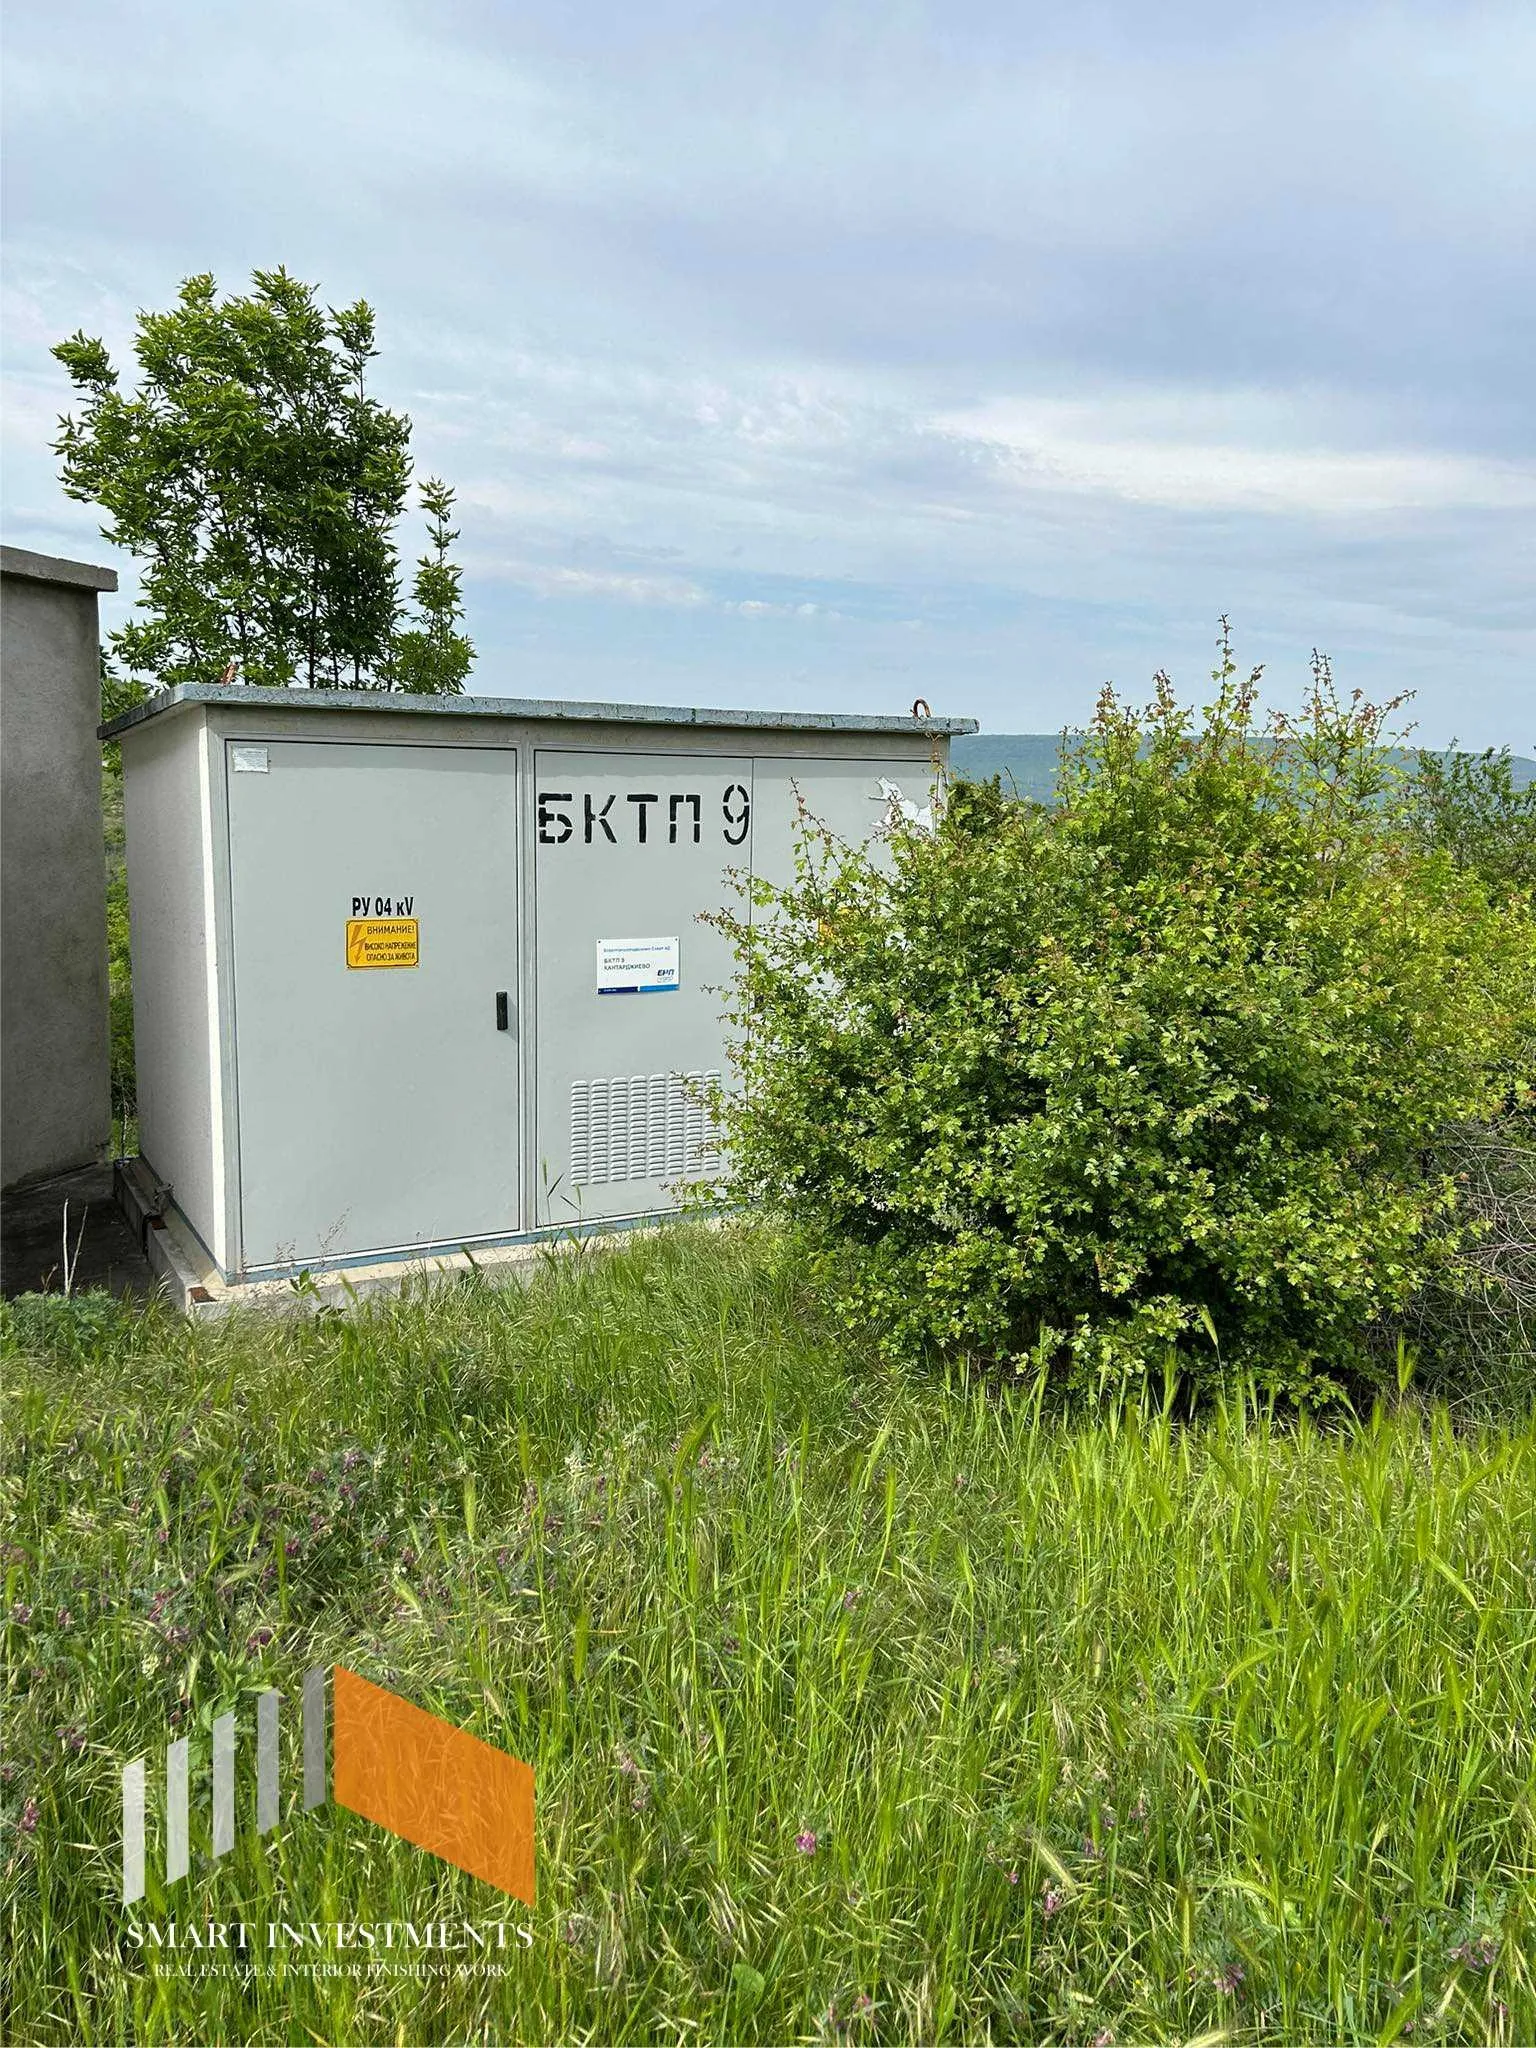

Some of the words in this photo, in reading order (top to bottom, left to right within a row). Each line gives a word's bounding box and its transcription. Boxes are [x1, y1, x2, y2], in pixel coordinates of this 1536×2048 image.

[539, 793, 701, 843] БКТП
[722, 784, 750, 845] 9
[352, 896, 371, 916] РУ
[375, 896, 392, 916] 04
[367, 924, 415, 935] ВНИМАНИЕ!
[604, 963, 651, 971] КАНТАРДЖИЕВО
